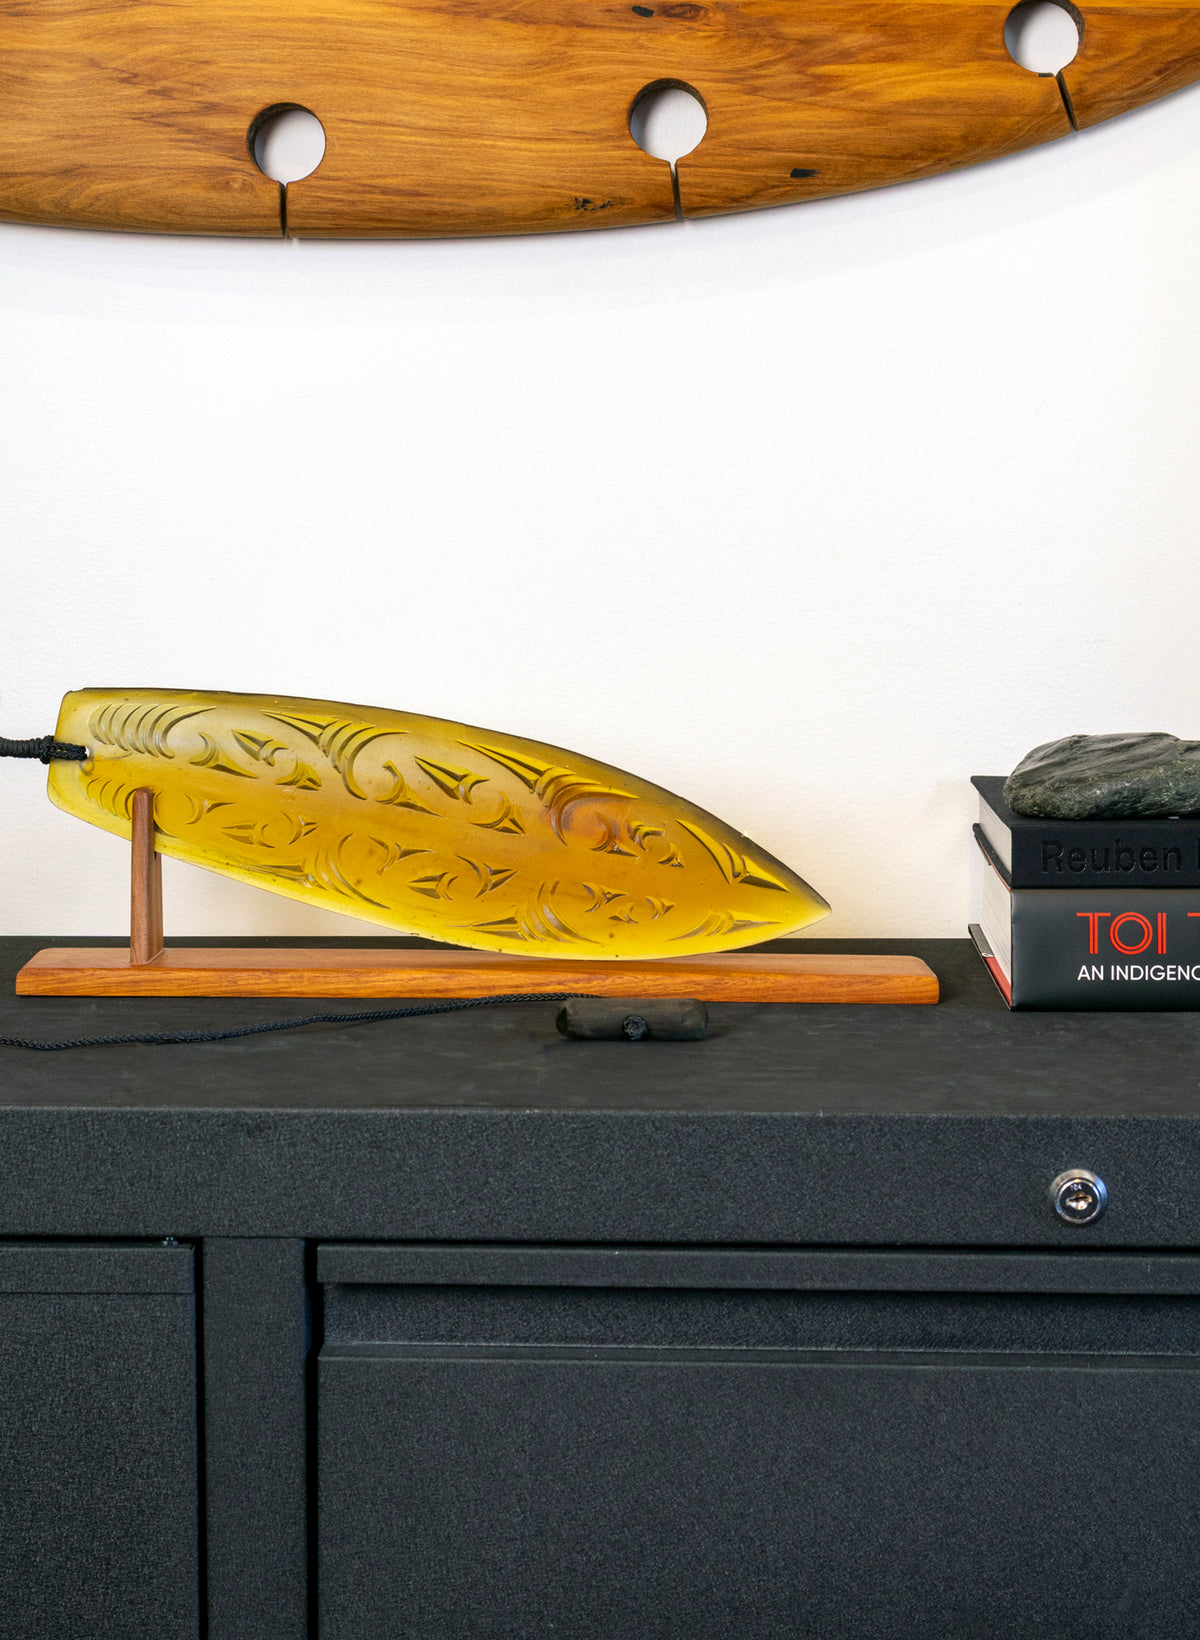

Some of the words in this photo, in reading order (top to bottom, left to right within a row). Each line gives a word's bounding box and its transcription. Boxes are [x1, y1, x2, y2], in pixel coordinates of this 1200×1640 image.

[1041, 839, 1183, 874] Reuben
[1076, 912, 1167, 955] TOI
[1077, 965, 1104, 981] AN
